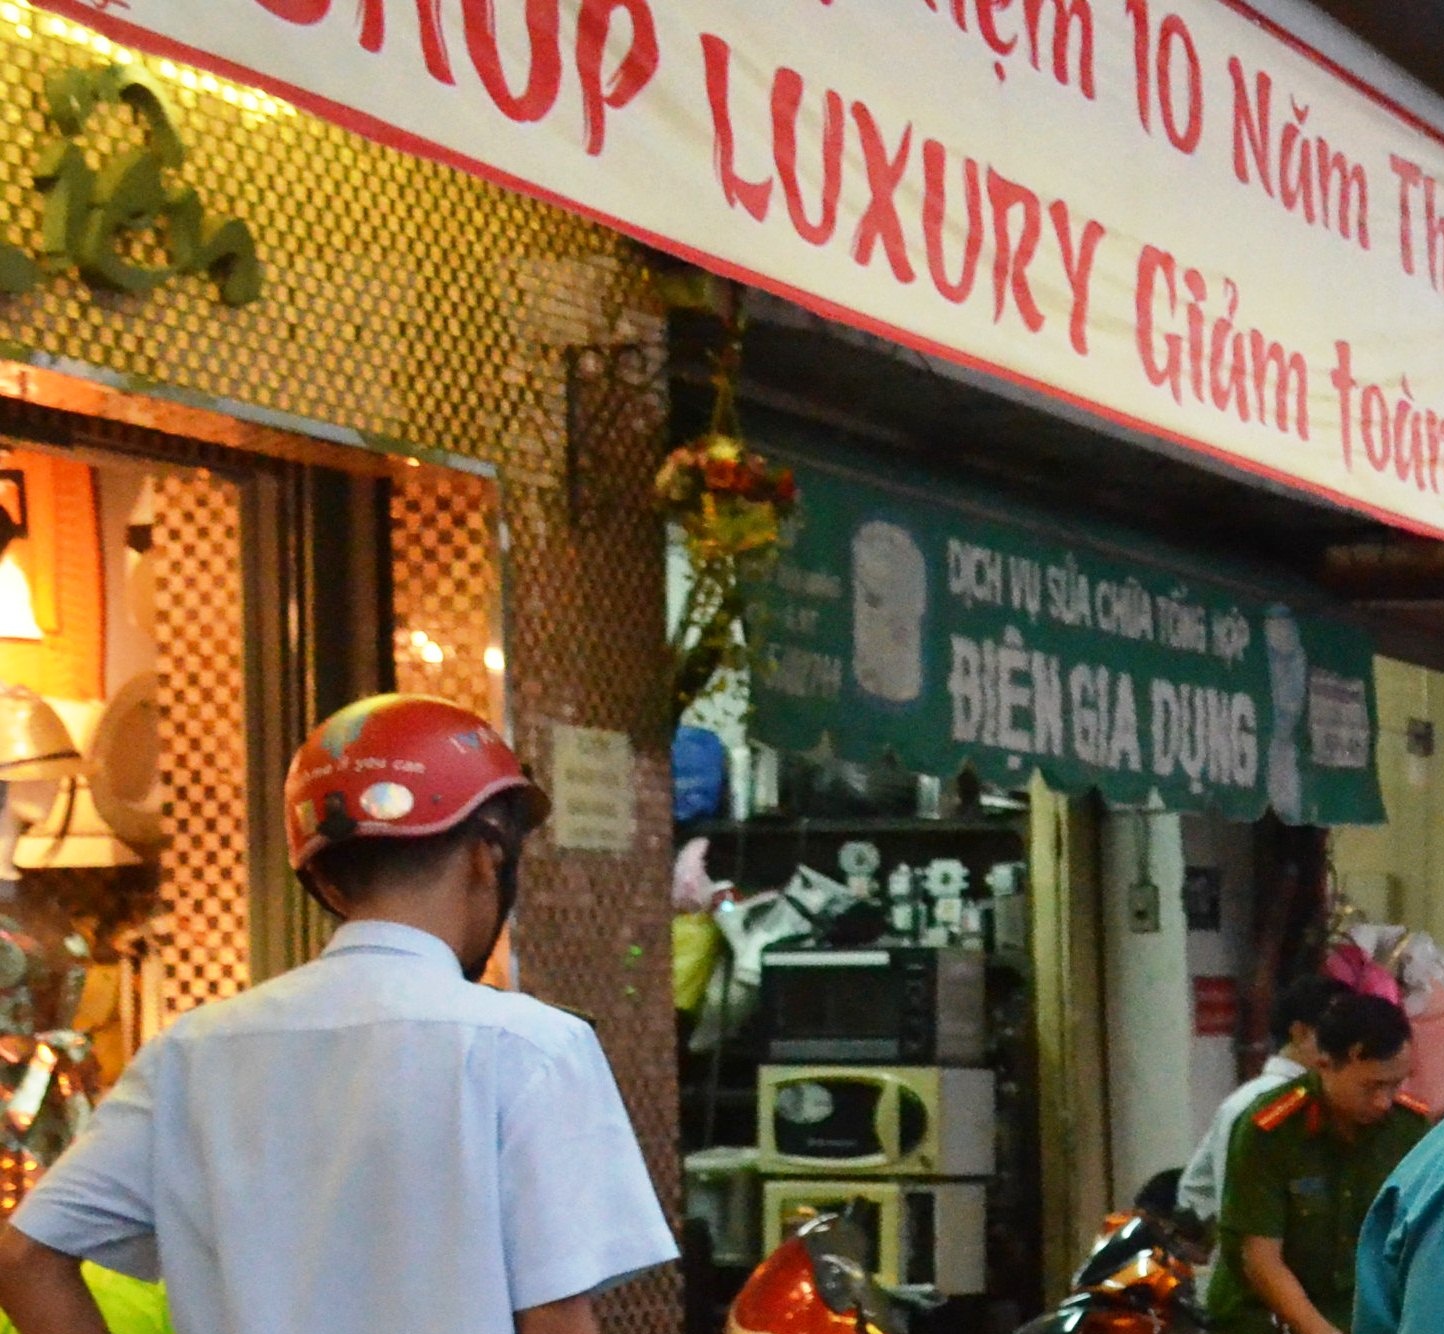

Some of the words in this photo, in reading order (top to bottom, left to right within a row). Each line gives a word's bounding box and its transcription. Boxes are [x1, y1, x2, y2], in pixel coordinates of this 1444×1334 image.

[699, 32, 1107, 356] LUXURY
[1135, 243, 1310, 442] Giảm
[1126, 0, 1203, 155] 10
[1228, 55, 1371, 251] Năm
[1068, 660, 1143, 774] GIA
[1150, 676, 1259, 796] DỤNG
